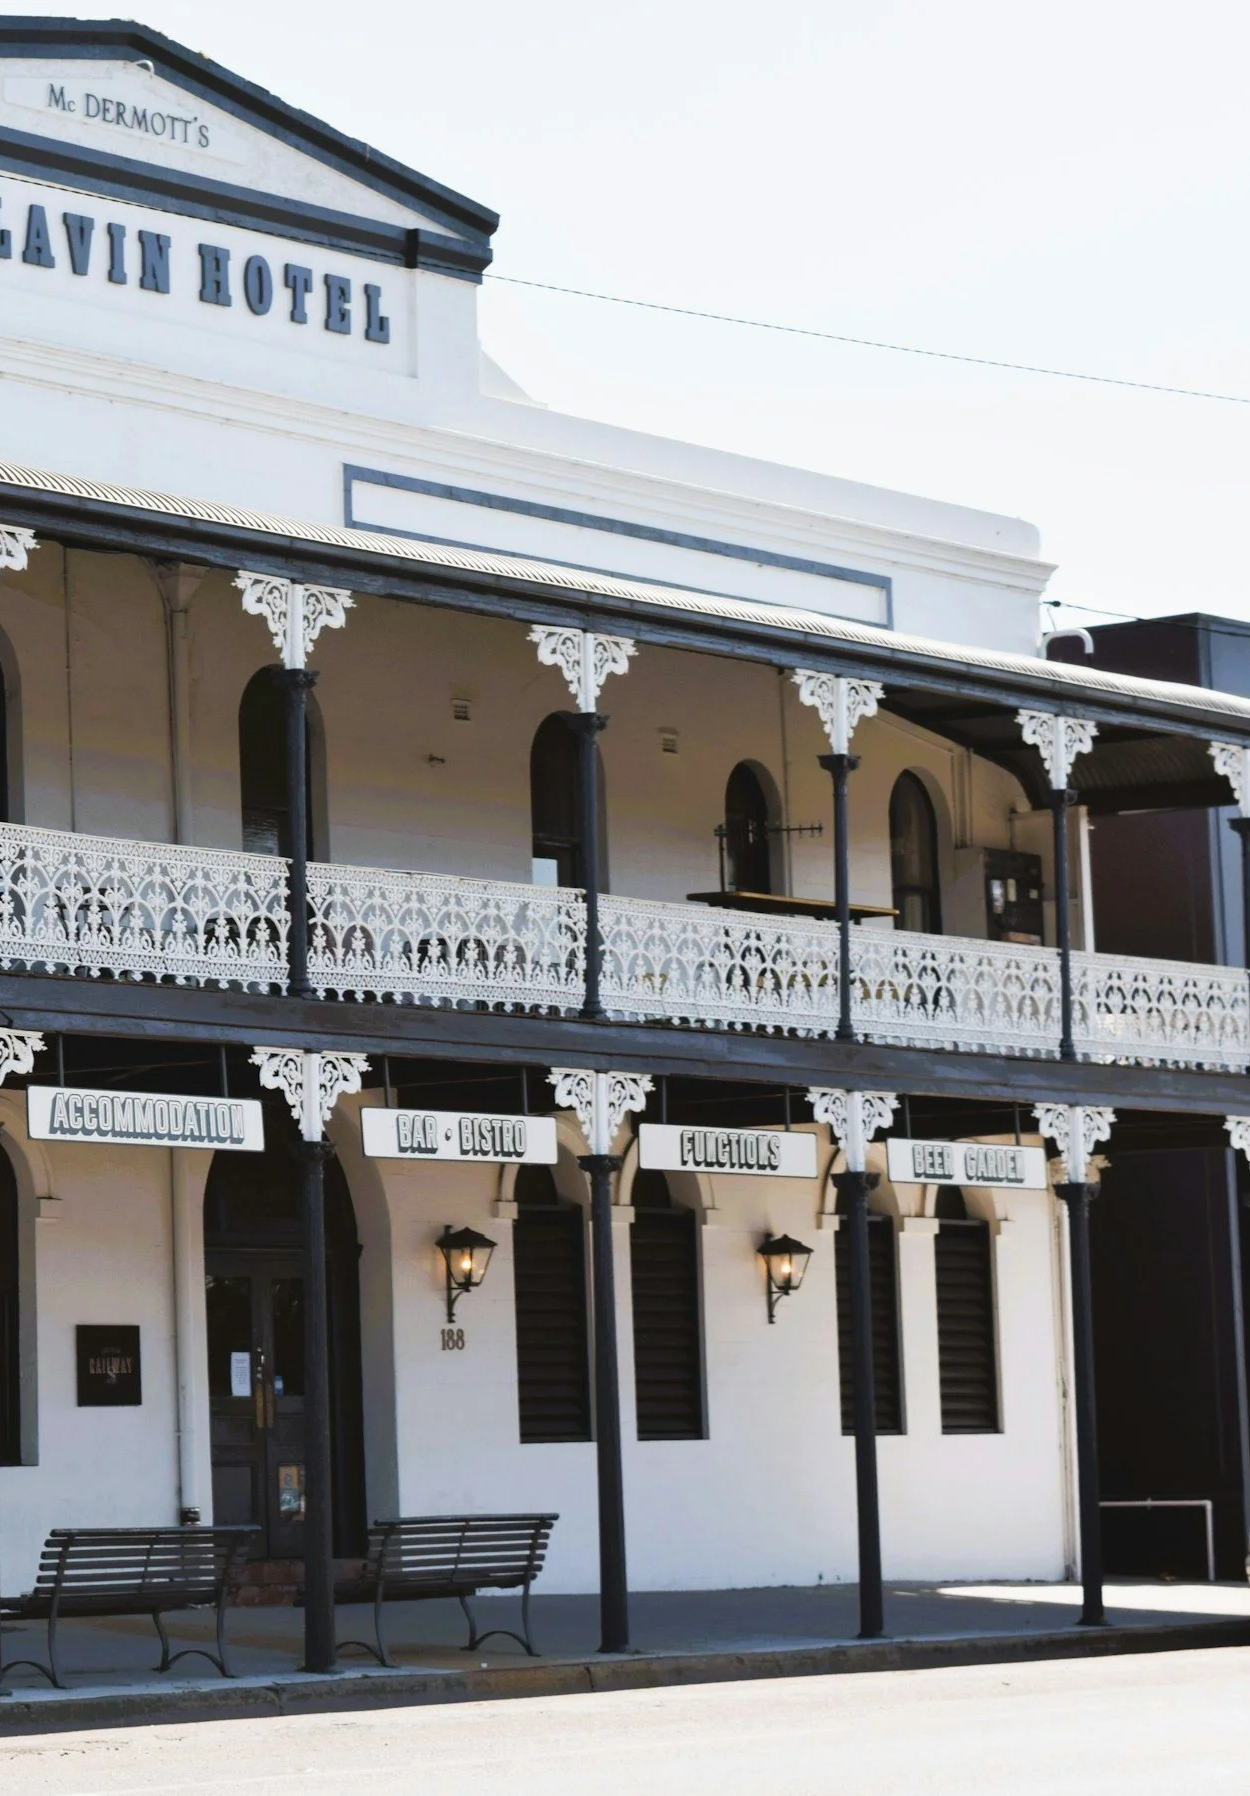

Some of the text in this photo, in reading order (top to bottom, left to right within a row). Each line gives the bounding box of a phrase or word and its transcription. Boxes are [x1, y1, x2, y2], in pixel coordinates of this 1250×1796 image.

[47, 83, 210, 149] Mc DERMOTT'S
[198, 242, 390, 344] HOTEL
[49, 1092, 245, 1144] ACCOMMODATION
[397, 1114, 527, 1157] BAR BISTRO
[681, 1130, 781, 1170] FUNCTIONS
[913, 1144, 1025, 1183] BEER GARDEN
[440, 1329, 465, 1351] 188
